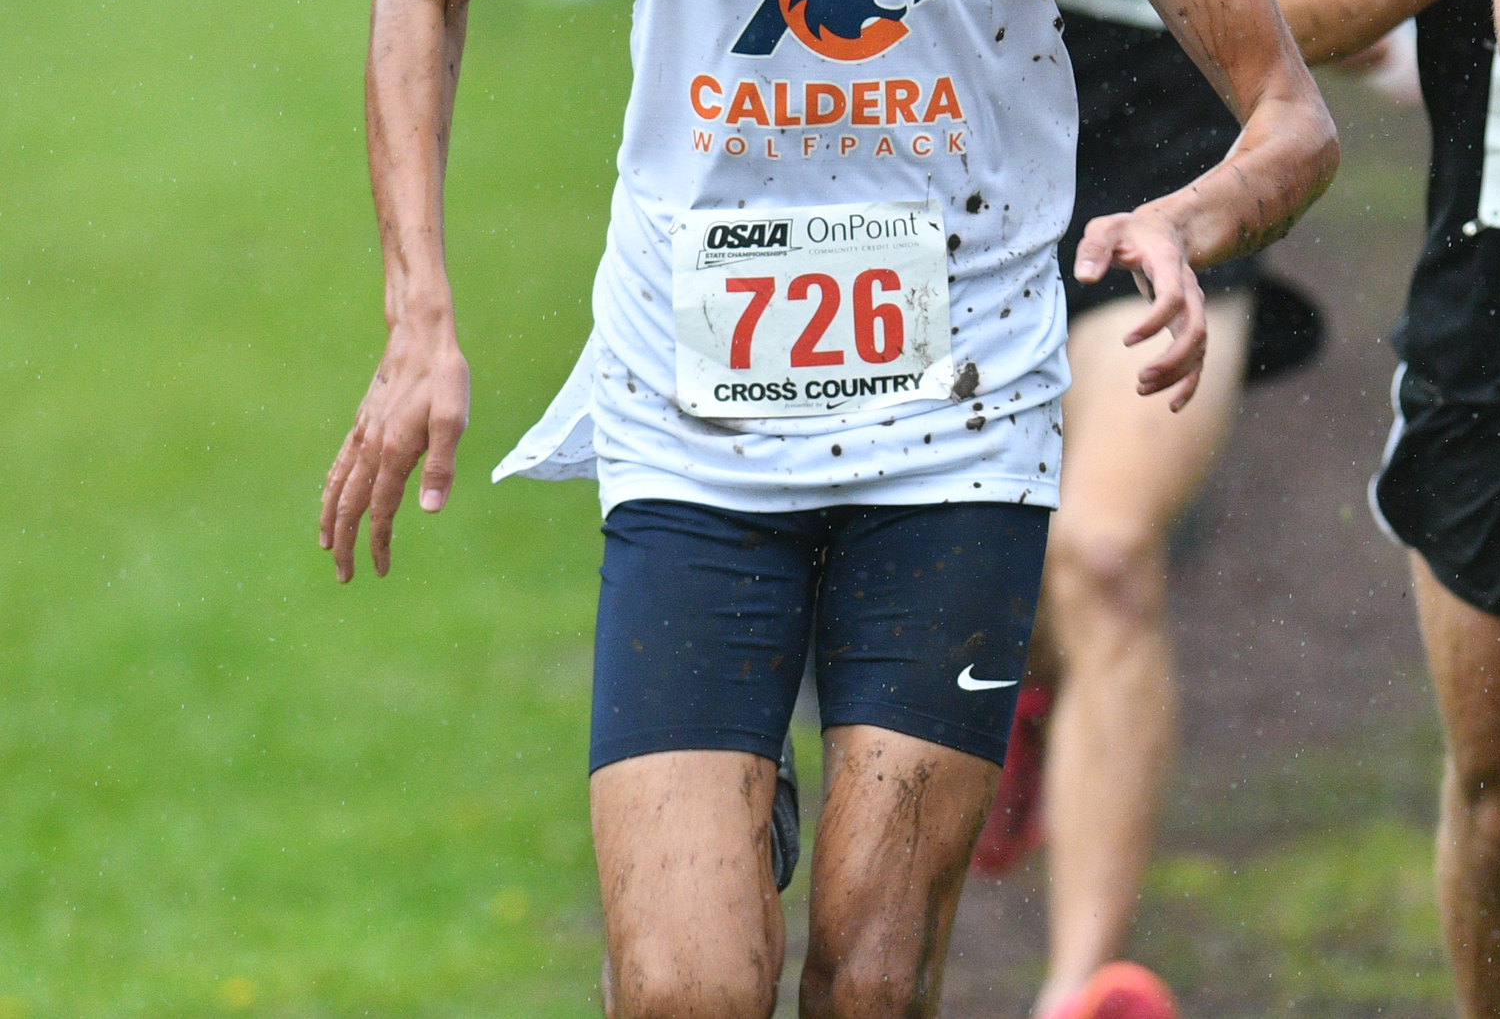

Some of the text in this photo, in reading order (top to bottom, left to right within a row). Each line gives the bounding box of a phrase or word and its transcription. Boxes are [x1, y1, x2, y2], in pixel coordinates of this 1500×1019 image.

[690, 75, 962, 126] CALDERA
[693, 130, 965, 157] WOLFPACK
[707, 223, 789, 249] OSAA
[807, 212, 919, 243] OnPoint
[705, 250, 788, 259] STATE CHAMPIONSHIPS
[808, 241, 920, 255] COMMUNITY CREDIT UNION
[726, 268, 904, 369] 726
[714, 373, 924, 401] CROSS COUNTRY
